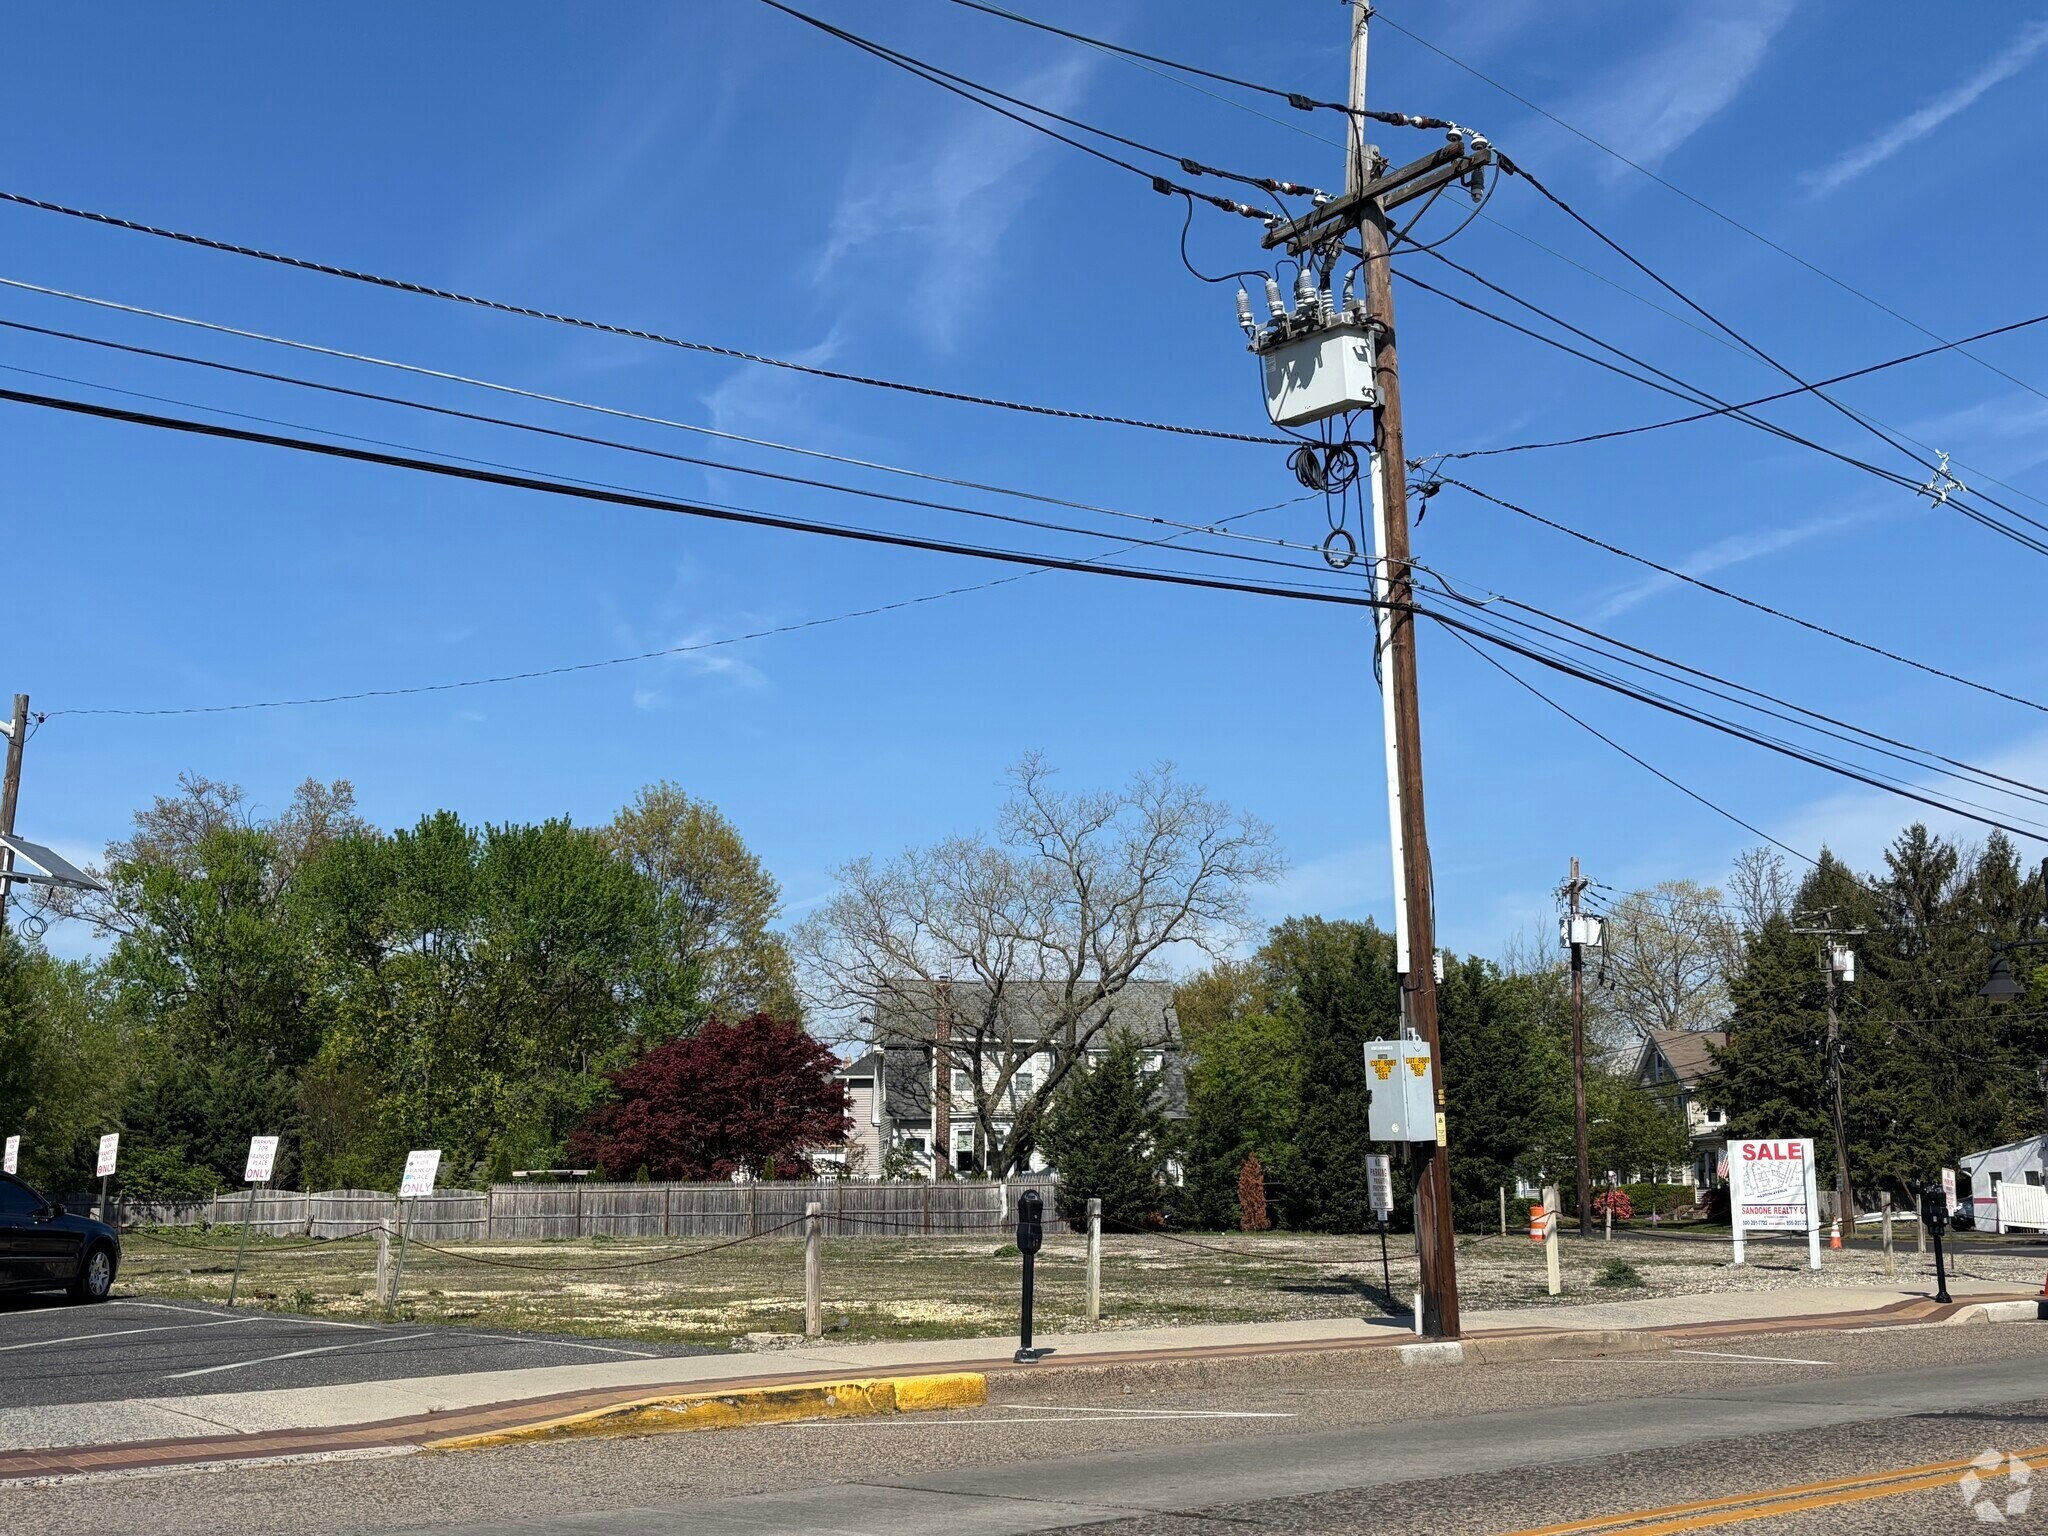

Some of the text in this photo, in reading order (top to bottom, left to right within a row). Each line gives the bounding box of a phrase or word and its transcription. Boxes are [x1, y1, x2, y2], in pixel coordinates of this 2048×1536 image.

[1410, 1063, 1420, 1071] SEC
[1742, 1143, 1802, 1161] SALE
[98, 1163, 114, 1175] ONLY
[247, 1168, 271, 1179] ONLY
[1370, 1168, 1387, 1178] PARKING
[403, 1182, 433, 1194] ONLY
[1742, 1206, 1772, 1215] SANDONE
[1773, 1206, 1798, 1215] REALTY
